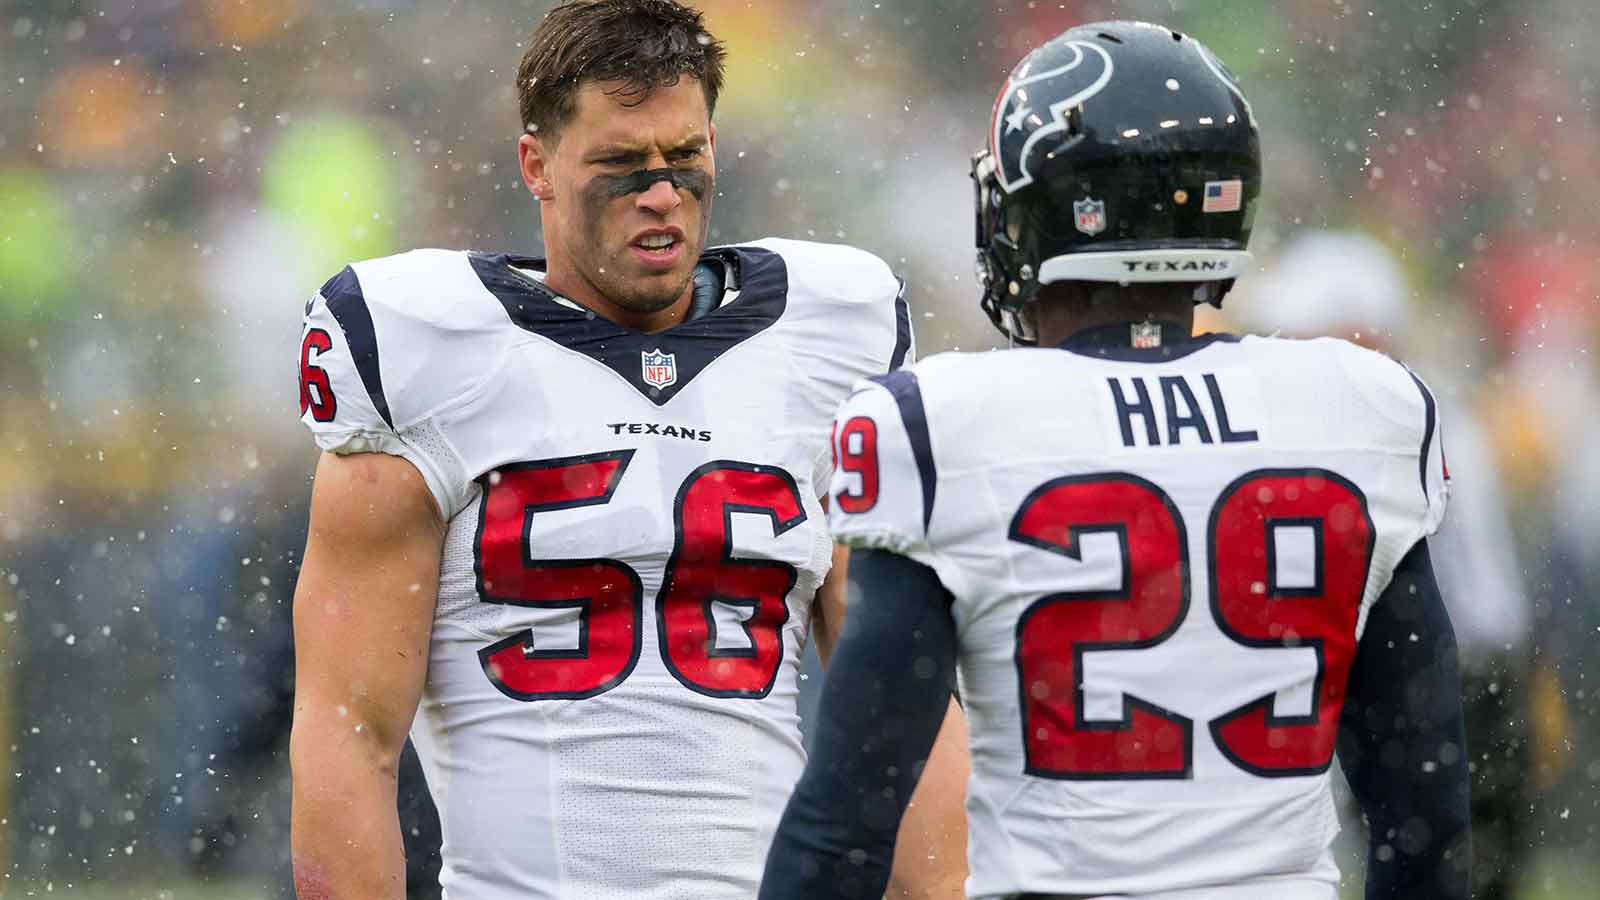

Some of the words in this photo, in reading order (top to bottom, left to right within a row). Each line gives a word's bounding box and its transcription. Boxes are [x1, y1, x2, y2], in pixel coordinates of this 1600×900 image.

[1122, 261, 1230, 272] TEXANS
[298, 328, 337, 422] 6
[647, 366, 672, 384] NFL
[1107, 374, 1258, 447] HAL
[606, 422, 712, 442] TEXANS
[832, 416, 880, 514] 9
[475, 449, 807, 701] 56
[1009, 468, 1376, 780] 29
